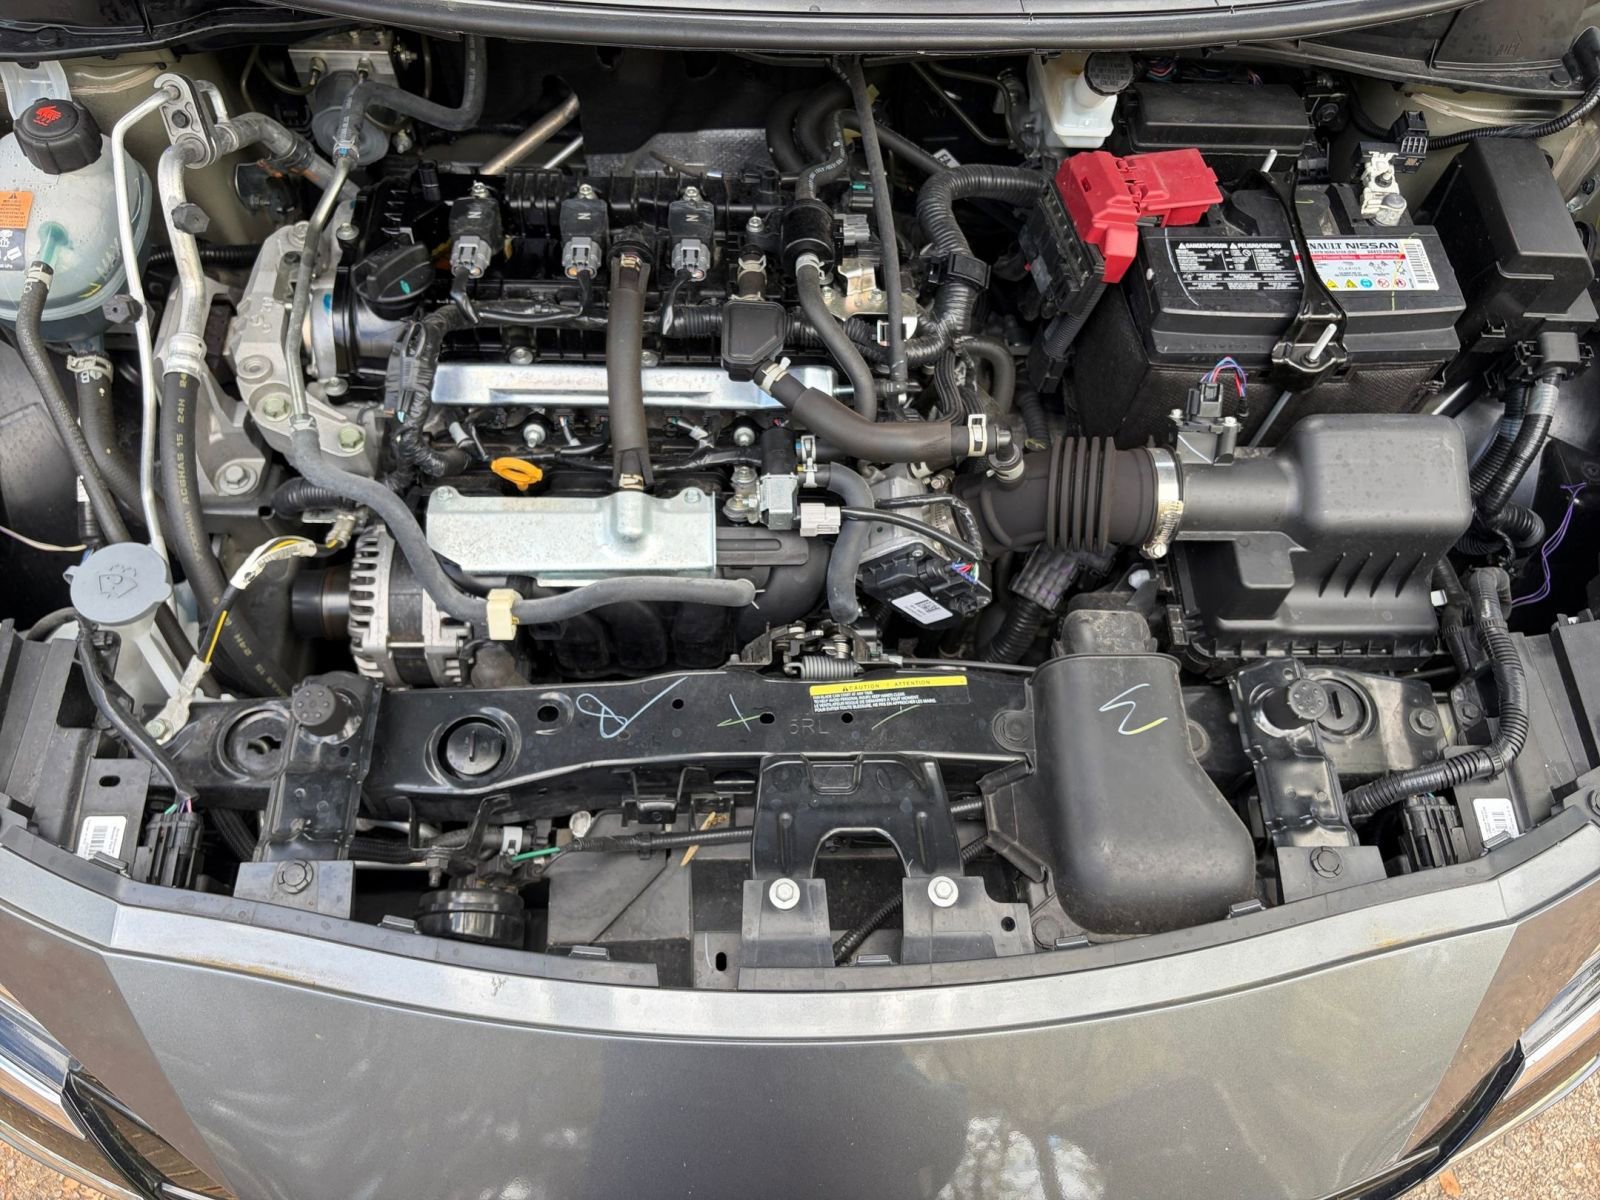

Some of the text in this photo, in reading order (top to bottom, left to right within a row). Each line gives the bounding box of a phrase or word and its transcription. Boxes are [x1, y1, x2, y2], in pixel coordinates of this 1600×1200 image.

[1308, 242, 1399, 250] NAULT NISSAN
[177, 398, 186, 424] 24H
[849, 683, 880, 691] CAUTION
[894, 679, 931, 688] ATTENTION
